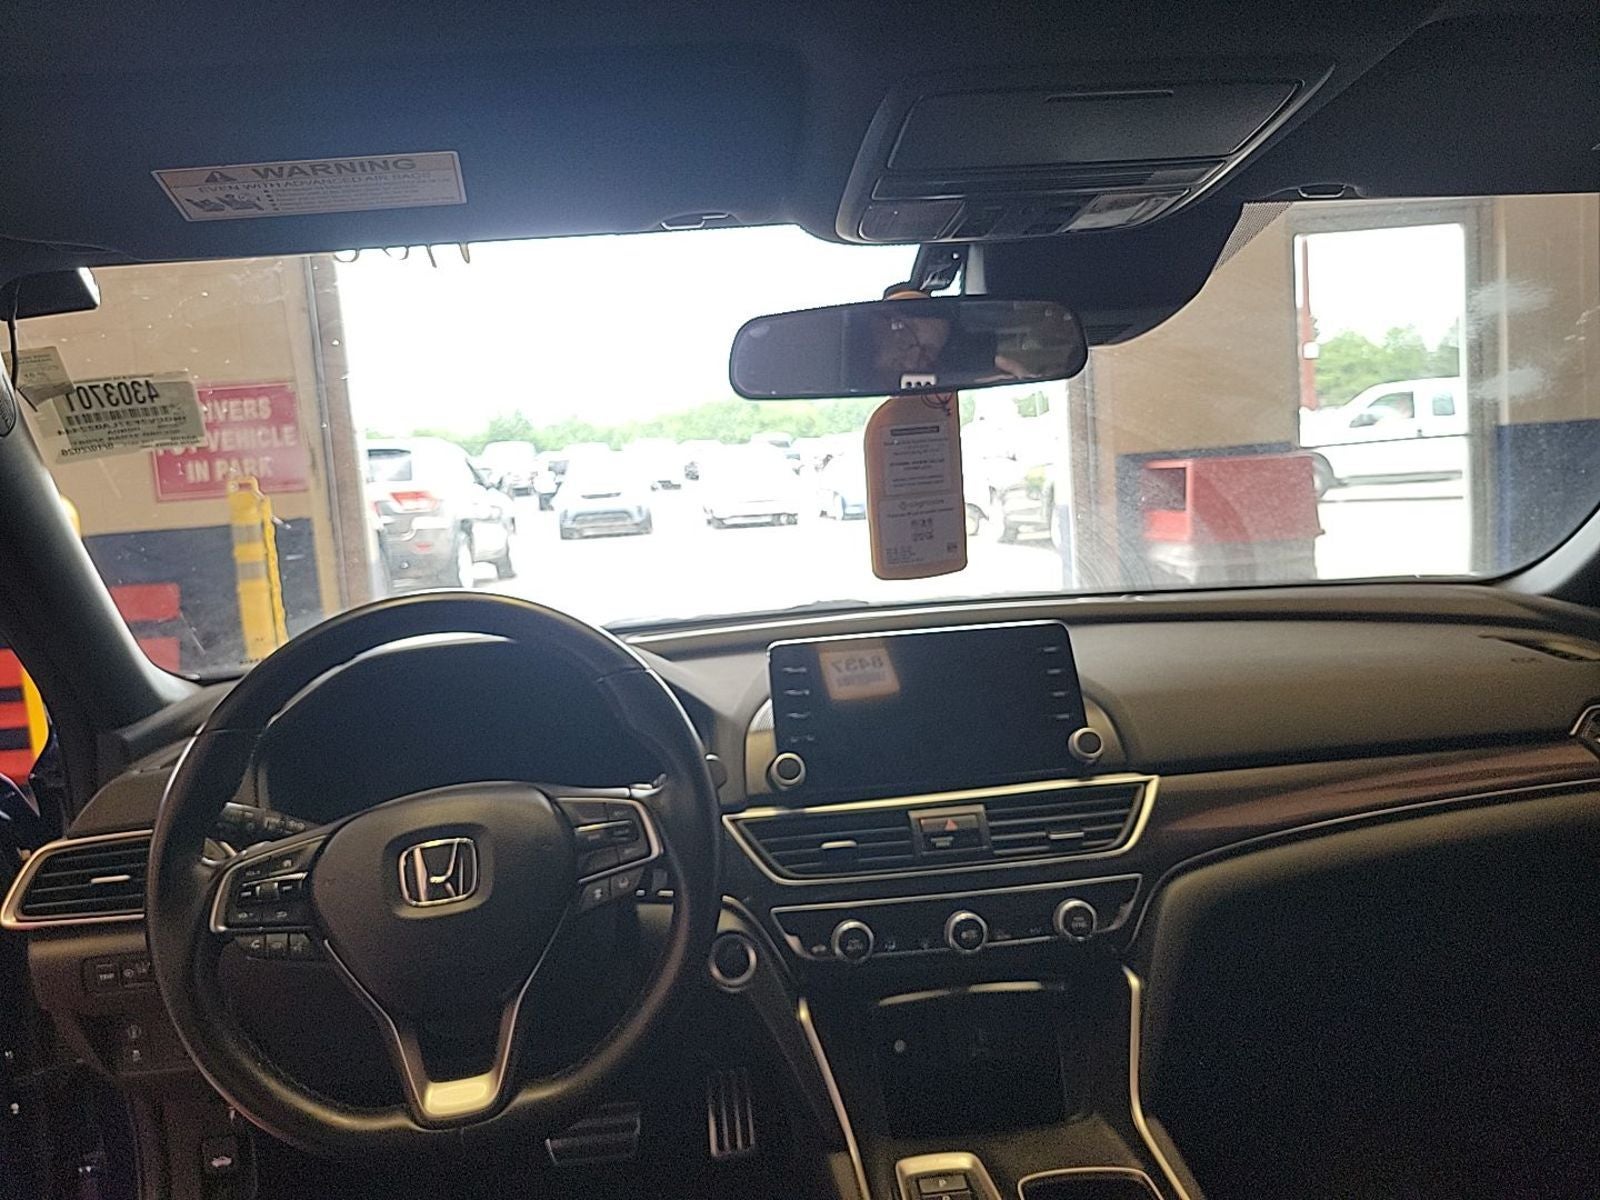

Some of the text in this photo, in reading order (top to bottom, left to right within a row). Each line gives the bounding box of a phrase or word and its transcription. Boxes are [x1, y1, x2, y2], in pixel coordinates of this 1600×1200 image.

[251, 157, 417, 179] WARNING
[201, 395, 272, 423] IVERS
[205, 425, 298, 452] VEHICLE
[185, 456, 274, 483] IN PARK
